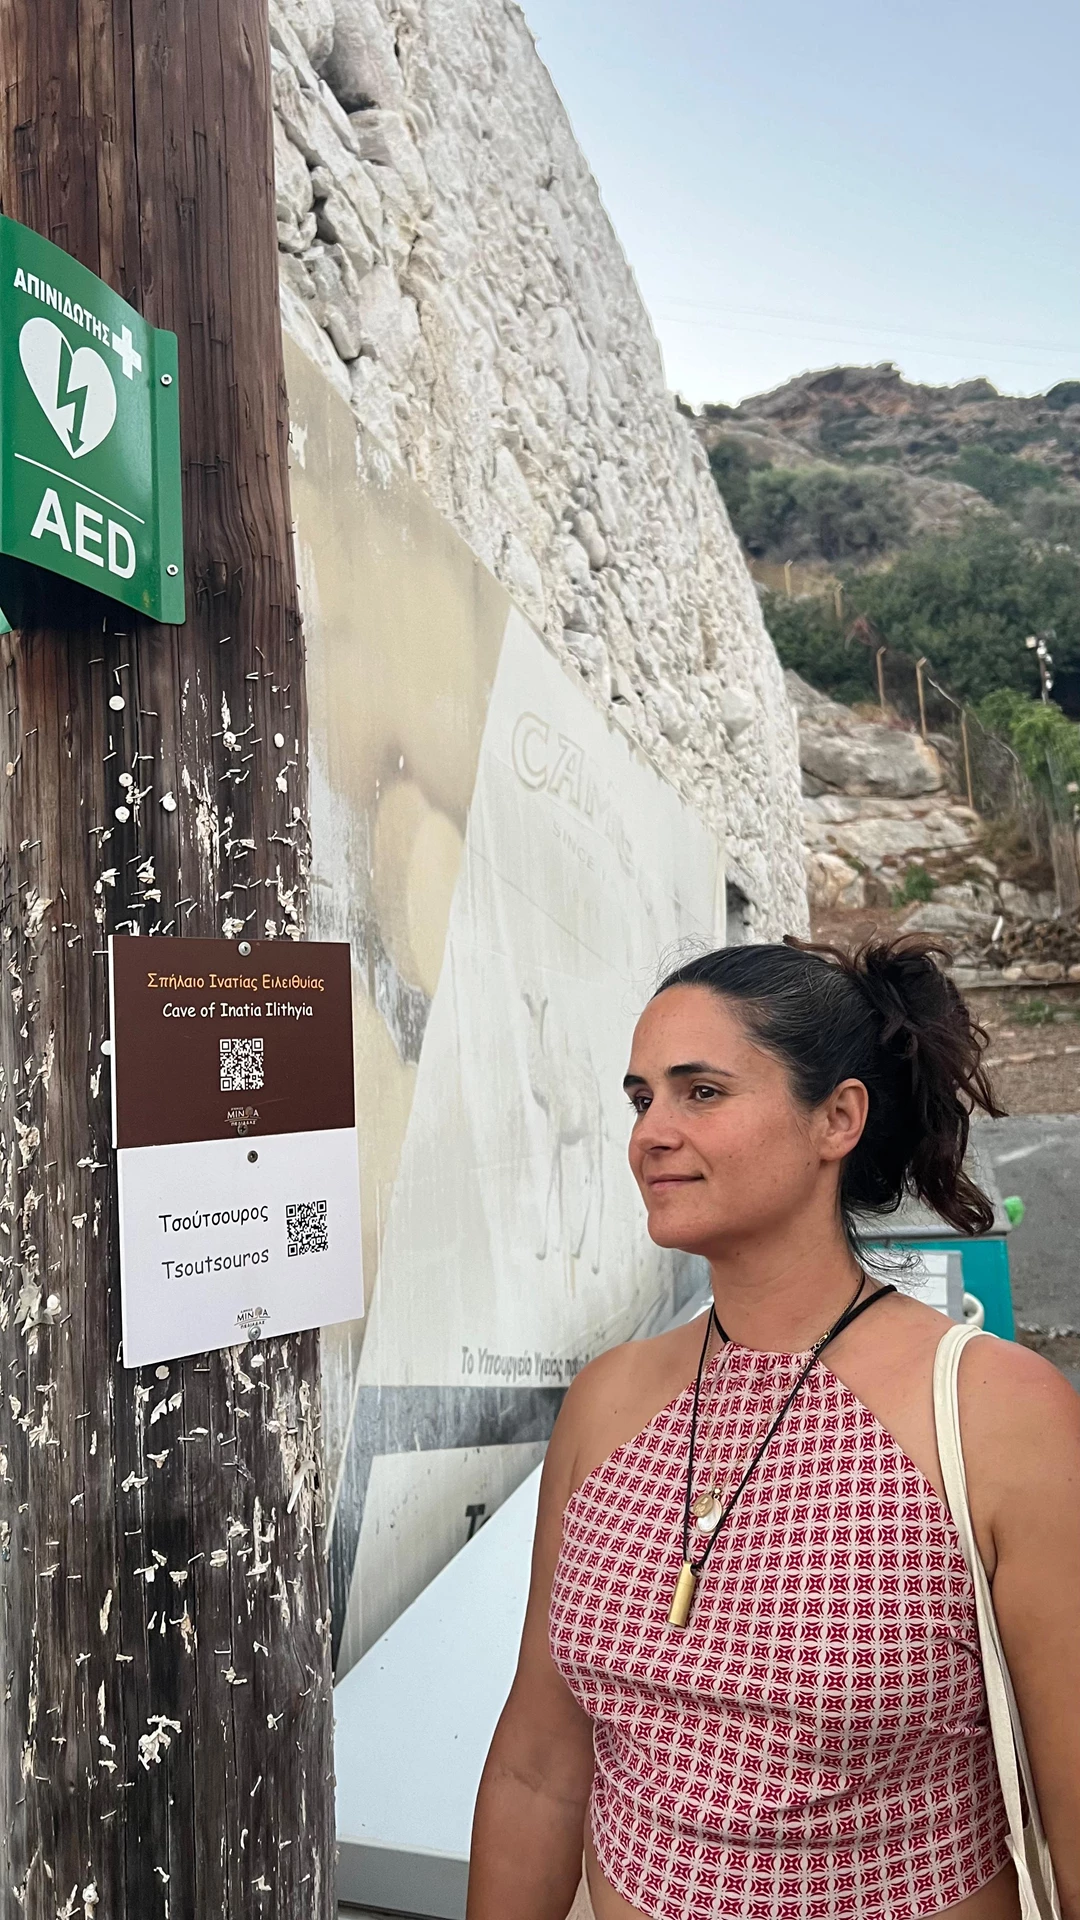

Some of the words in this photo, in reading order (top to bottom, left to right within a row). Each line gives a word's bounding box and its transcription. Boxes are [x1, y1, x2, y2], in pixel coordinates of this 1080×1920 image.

[13, 267, 110, 346] ΑΠΙΝΙΔΩΤΗΣ
[30, 487, 136, 580] AED
[552, 820, 595, 872] SINCE
[147, 972, 205, 992] Σπήλαιο
[209, 973, 258, 991] Ινατίας
[262, 974, 325, 991] Ειλειθυίας
[162, 1003, 197, 1018] Cave
[200, 1002, 216, 1018] of
[220, 1003, 262, 1017] Inatia
[265, 1002, 313, 1020] Ilithyia
[158, 1205, 269, 1233] Τσούτσουρος
[161, 1249, 270, 1280] Tsoutsouros
[461, 1346, 474, 1375] Το
[478, 1348, 532, 1383] Υπουργείο
[534, 1351, 564, 1383] Υγείας
